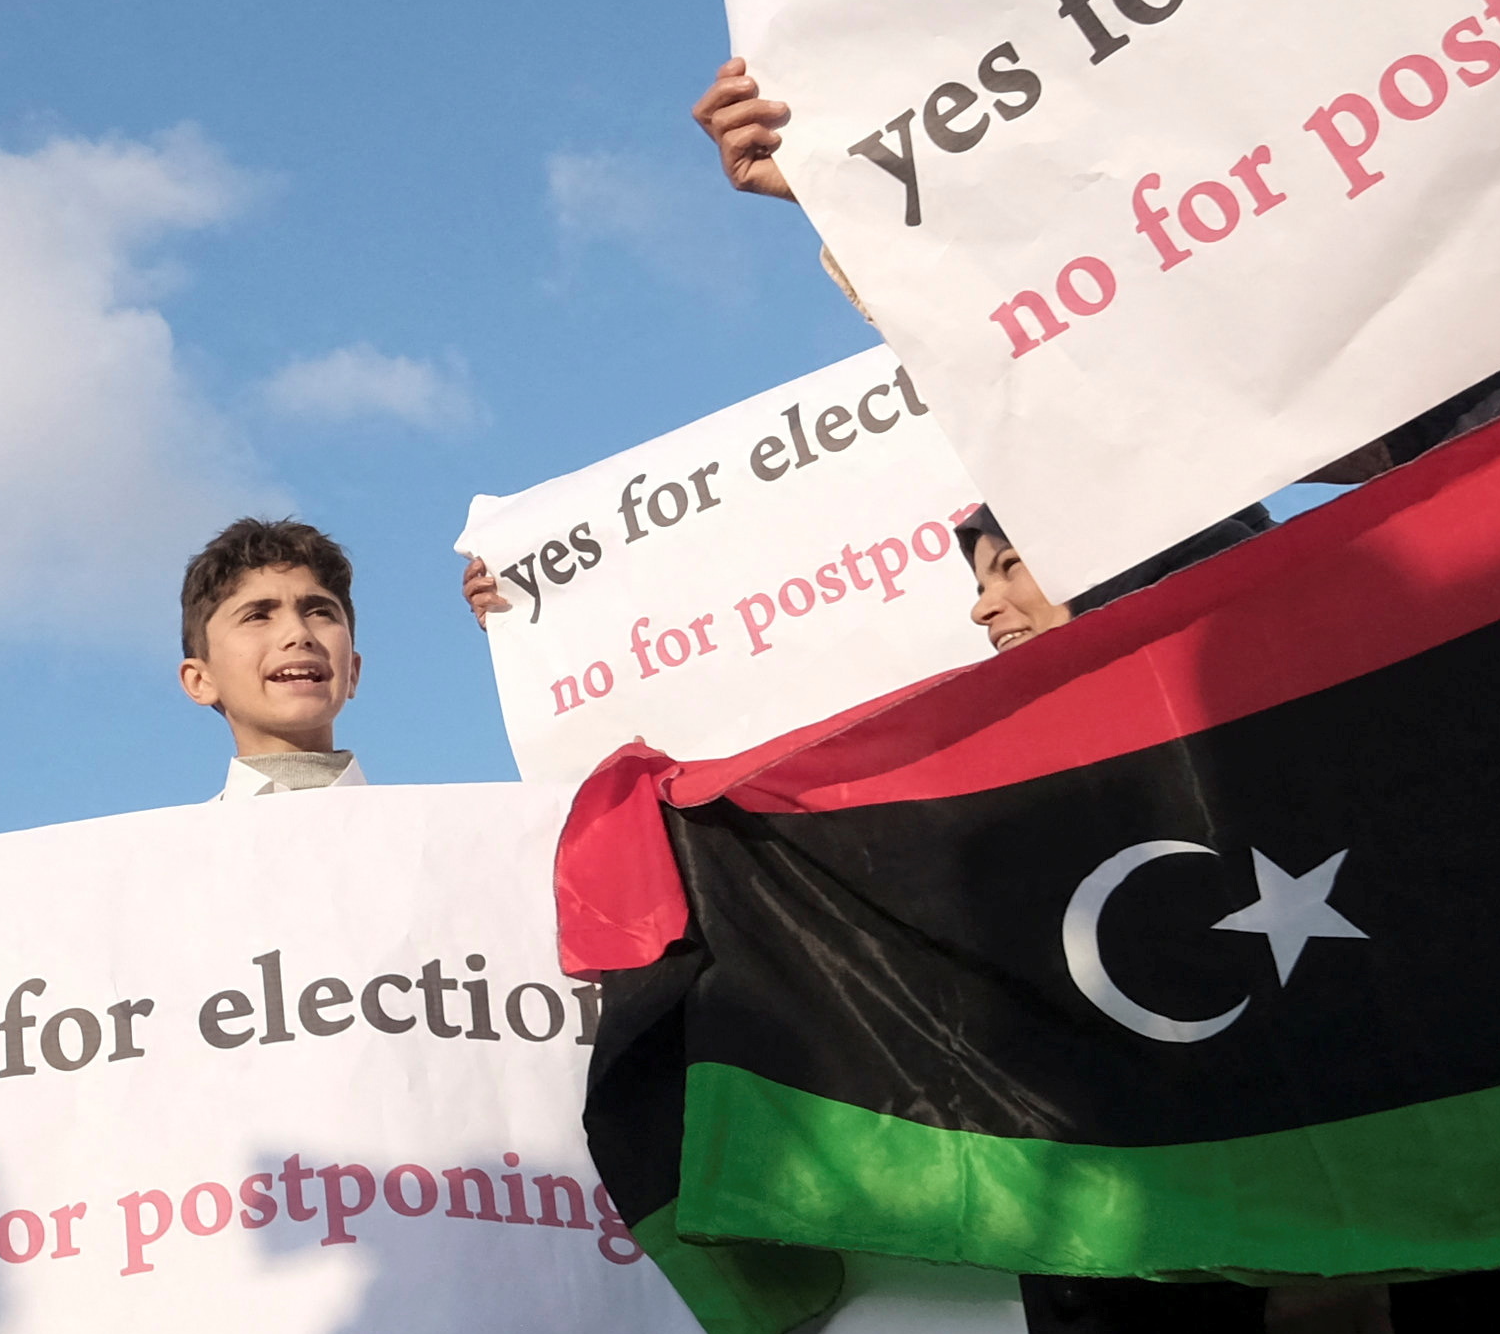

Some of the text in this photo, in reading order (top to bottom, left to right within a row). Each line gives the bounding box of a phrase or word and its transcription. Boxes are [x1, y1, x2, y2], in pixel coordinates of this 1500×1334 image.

[847, 37, 1044, 228] yes
[988, 249, 1118, 359] no
[1129, 143, 1287, 273] for
[500, 364, 930, 625] yes for elect
[549, 502, 985, 716] no for postpo
[117, 1150, 646, 1276] postponing
